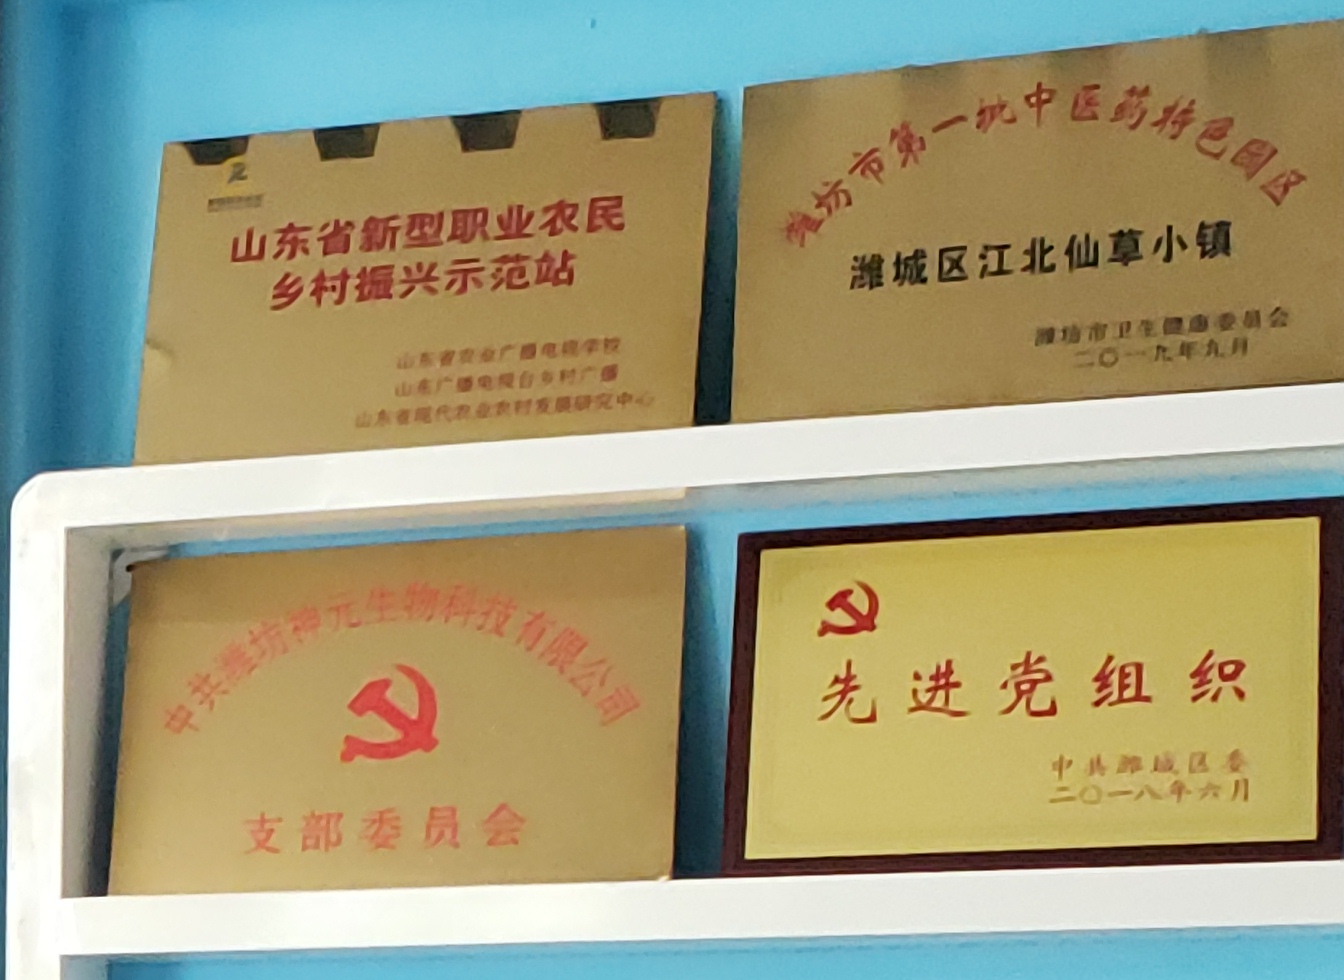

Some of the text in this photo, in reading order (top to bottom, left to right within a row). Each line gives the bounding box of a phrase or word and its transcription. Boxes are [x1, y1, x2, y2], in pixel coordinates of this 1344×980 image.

[230, 195, 625, 263] 山东省新型职业农民
[849, 220, 1233, 291] 潍城区江北仙草小镇
[269, 250, 577, 311] 乡村振兴示范站
[817, 648, 1249, 725] 先进党组织
[243, 802, 527, 856] 支部委员会
